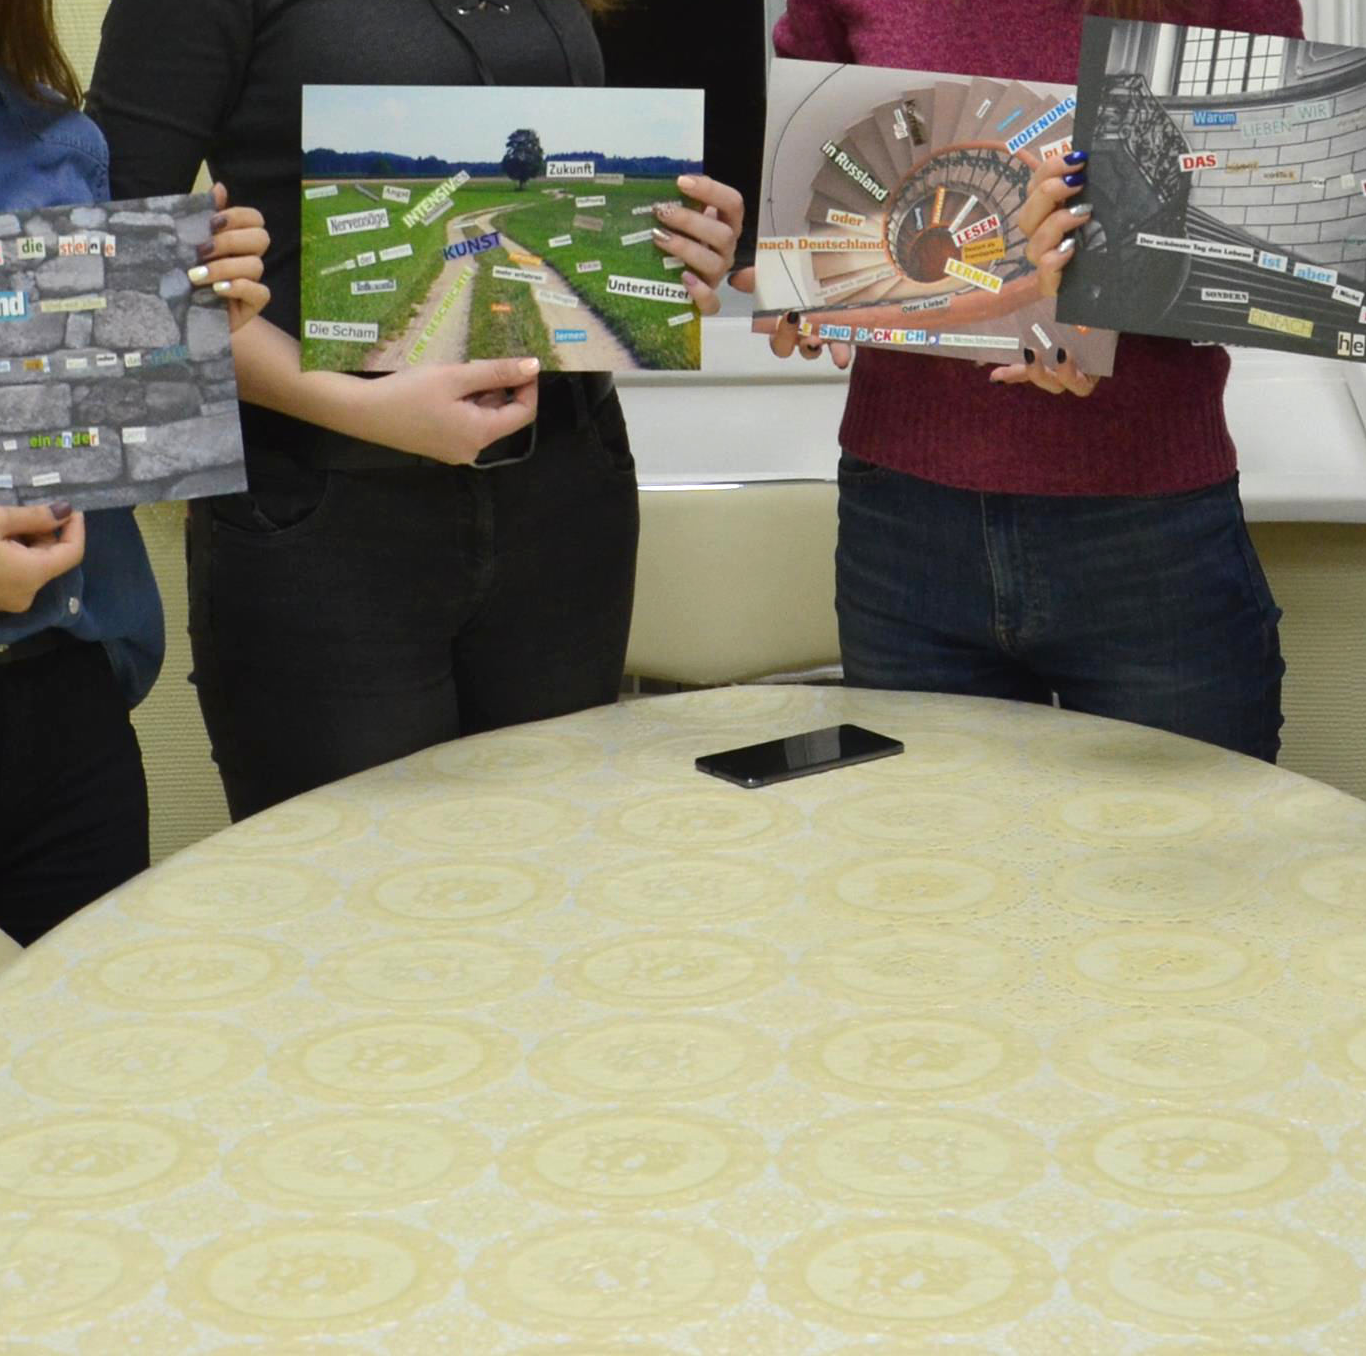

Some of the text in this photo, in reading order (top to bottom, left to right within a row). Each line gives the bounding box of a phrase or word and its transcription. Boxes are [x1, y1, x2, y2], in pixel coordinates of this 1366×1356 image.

[1194, 111, 1236, 124] Warum
[1298, 106, 1326, 119] WIR
[1008, 98, 1075, 152] HOFFNUNG
[1243, 121, 1291, 137] LIEBEN
[549, 163, 592, 176] Zukunft
[1183, 155, 1216, 169] DAS
[821, 141, 887, 201] In Russland
[830, 213, 862, 226] oder
[956, 217, 998, 244] LESEN
[22, 239, 43, 253] die
[443, 232, 501, 260] KUNST
[759, 239, 885, 250] nach Deutschland
[1194, 244, 1206, 253] Tag
[1296, 267, 1332, 283] aber
[515, 272, 543, 281] erfahren
[948, 260, 999, 290] LERNEN
[902, 298, 948, 314] Oder Liebe?
[1205, 291, 1247, 301] SONDERN
[1251, 310, 1312, 334] EINFACH
[309, 324, 376, 338] Die Scham
